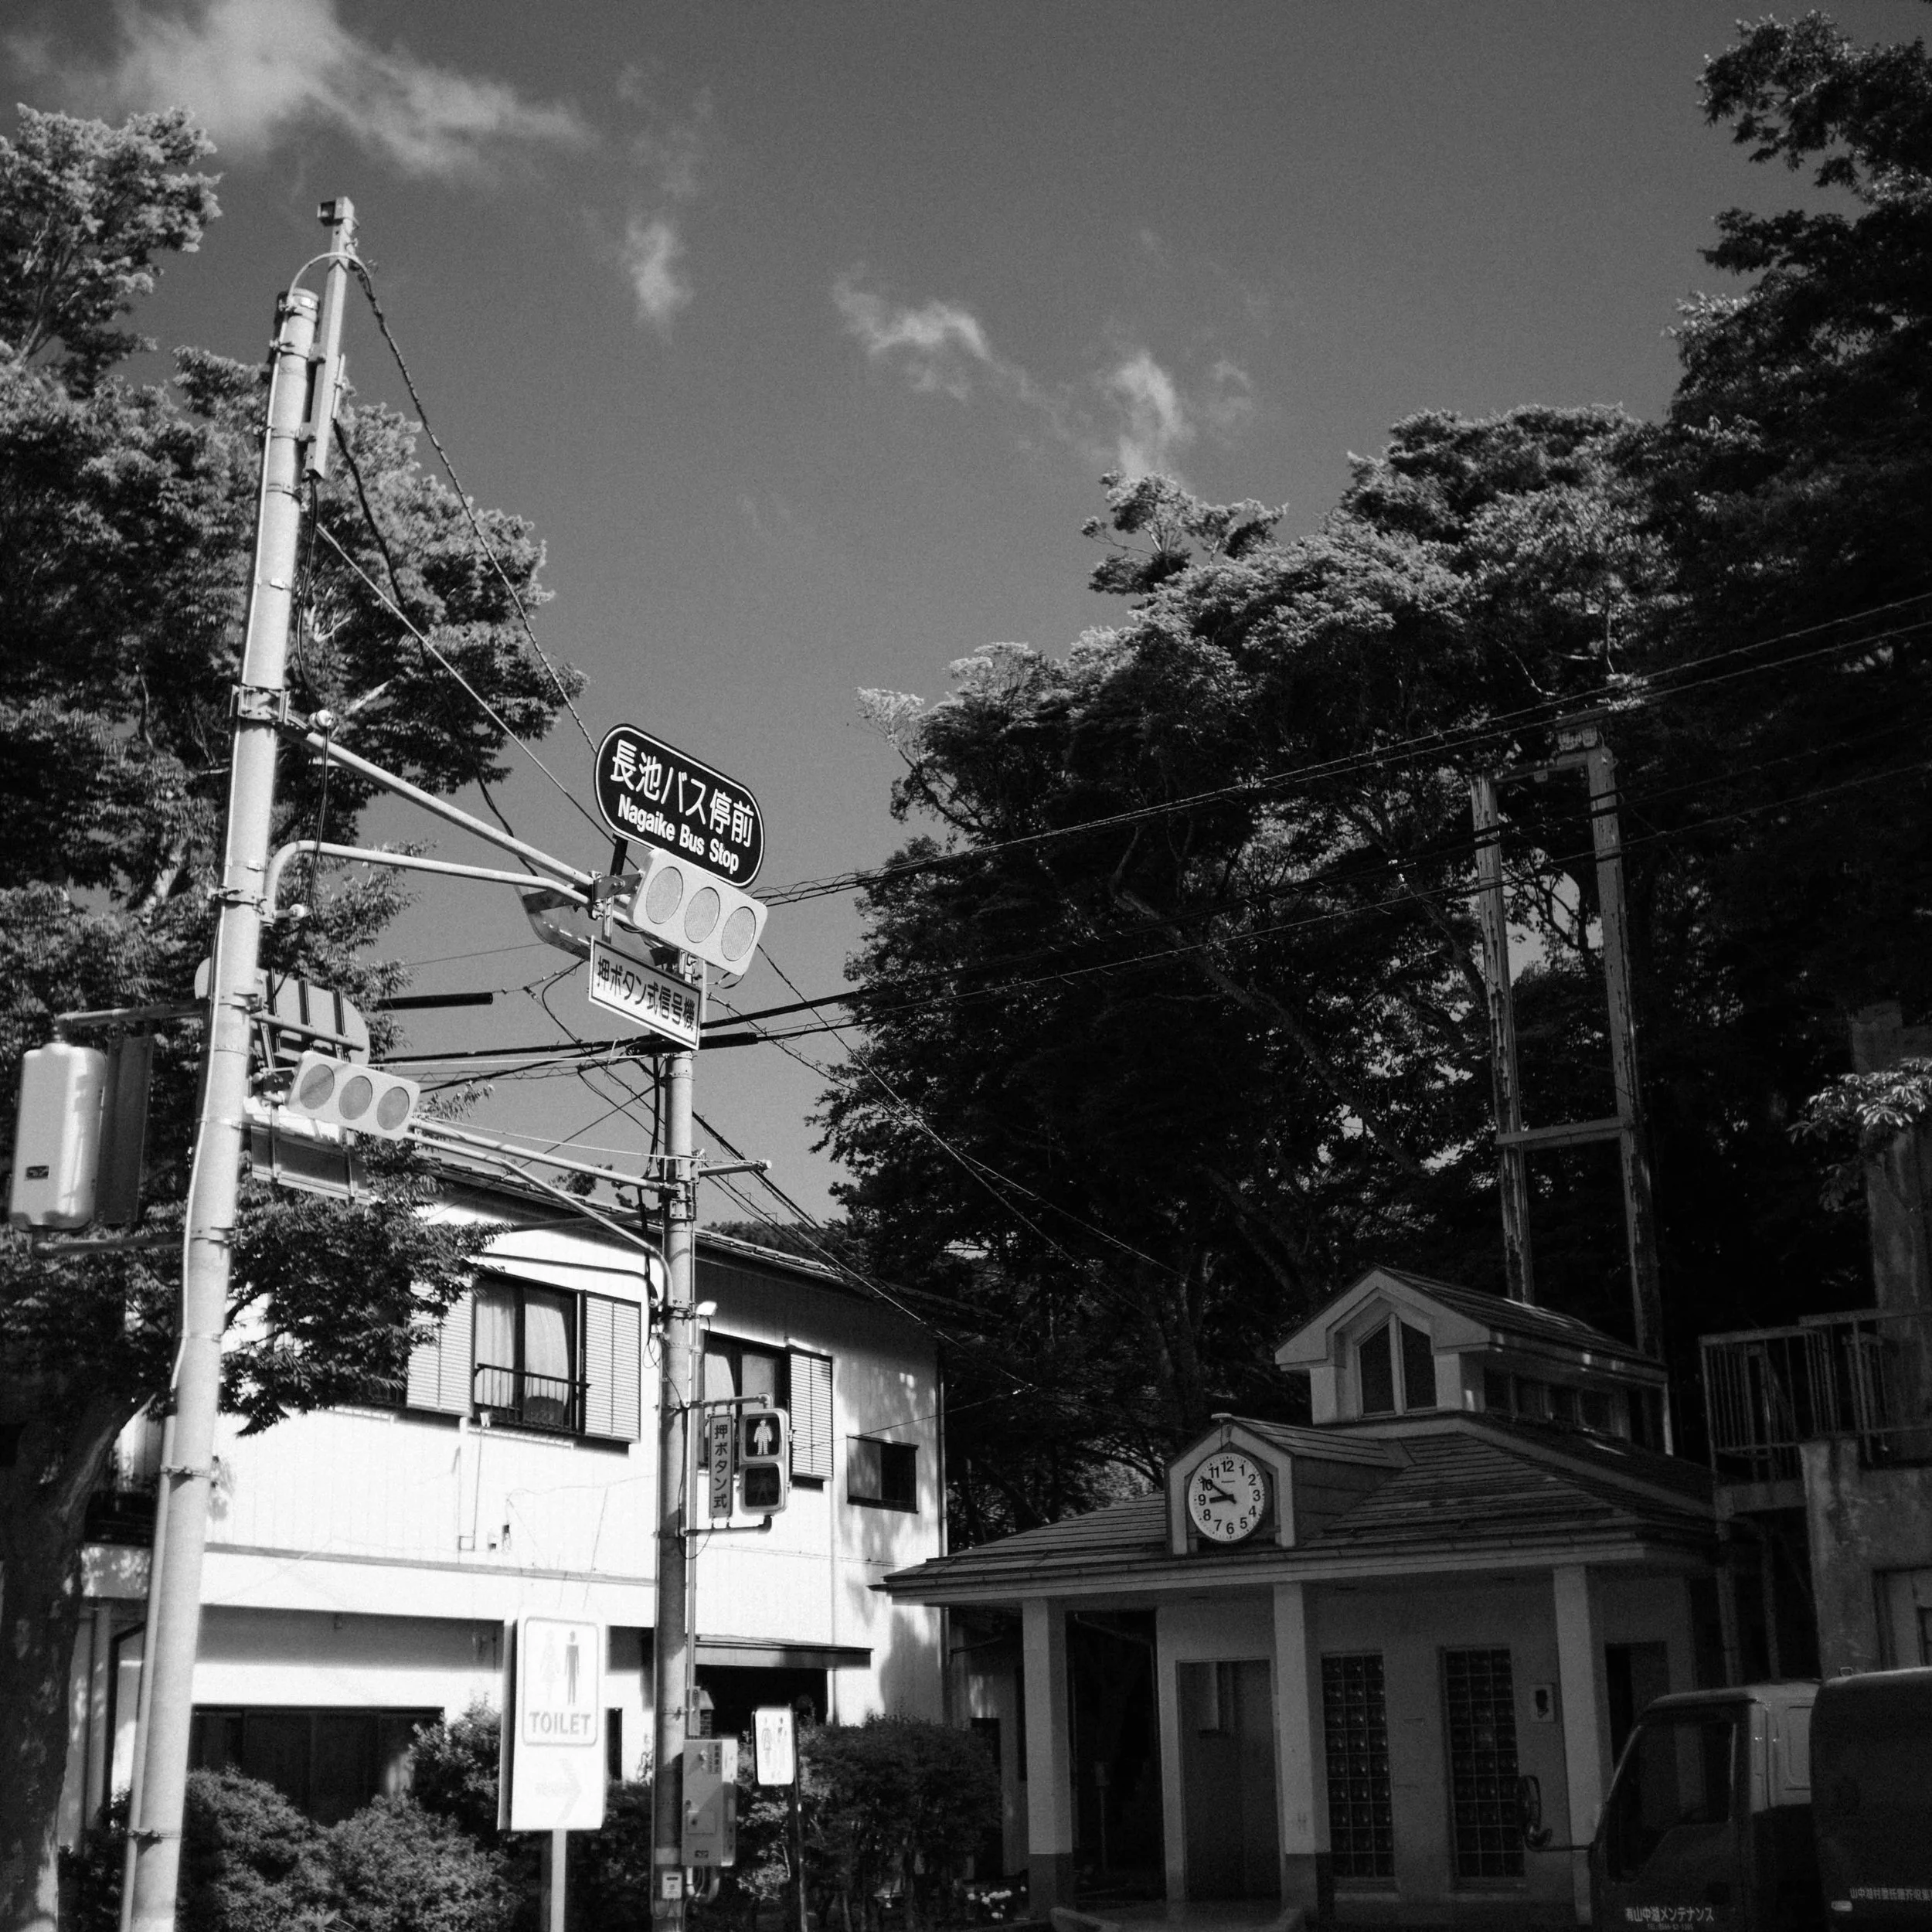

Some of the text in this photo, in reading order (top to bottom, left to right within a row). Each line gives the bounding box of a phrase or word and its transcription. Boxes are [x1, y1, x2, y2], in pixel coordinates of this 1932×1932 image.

[611, 739, 754, 847] 長池バス停前
[617, 794, 740, 875] Nagaike Bus Stop
[597, 955, 696, 1032] 押ボタン式信号機
[713, 1424, 728, 1509] 押ボタン式
[1209, 1466, 1219, 1478] 11
[1221, 1460, 1234, 1472] 12
[1239, 1464, 1245, 1476] 1
[1248, 1474, 1256, 1486] 2
[1198, 1494, 1206, 1505] 9
[1253, 1489, 1261, 1502] 3
[1203, 1509, 1211, 1521] 8
[1248, 1505, 1257, 1517] 4
[1214, 1519, 1222, 1531] 7
[1226, 1522, 1234, 1535] 6
[1240, 1517, 1248, 1529] 5
[529, 1711, 591, 1735] TOILET
